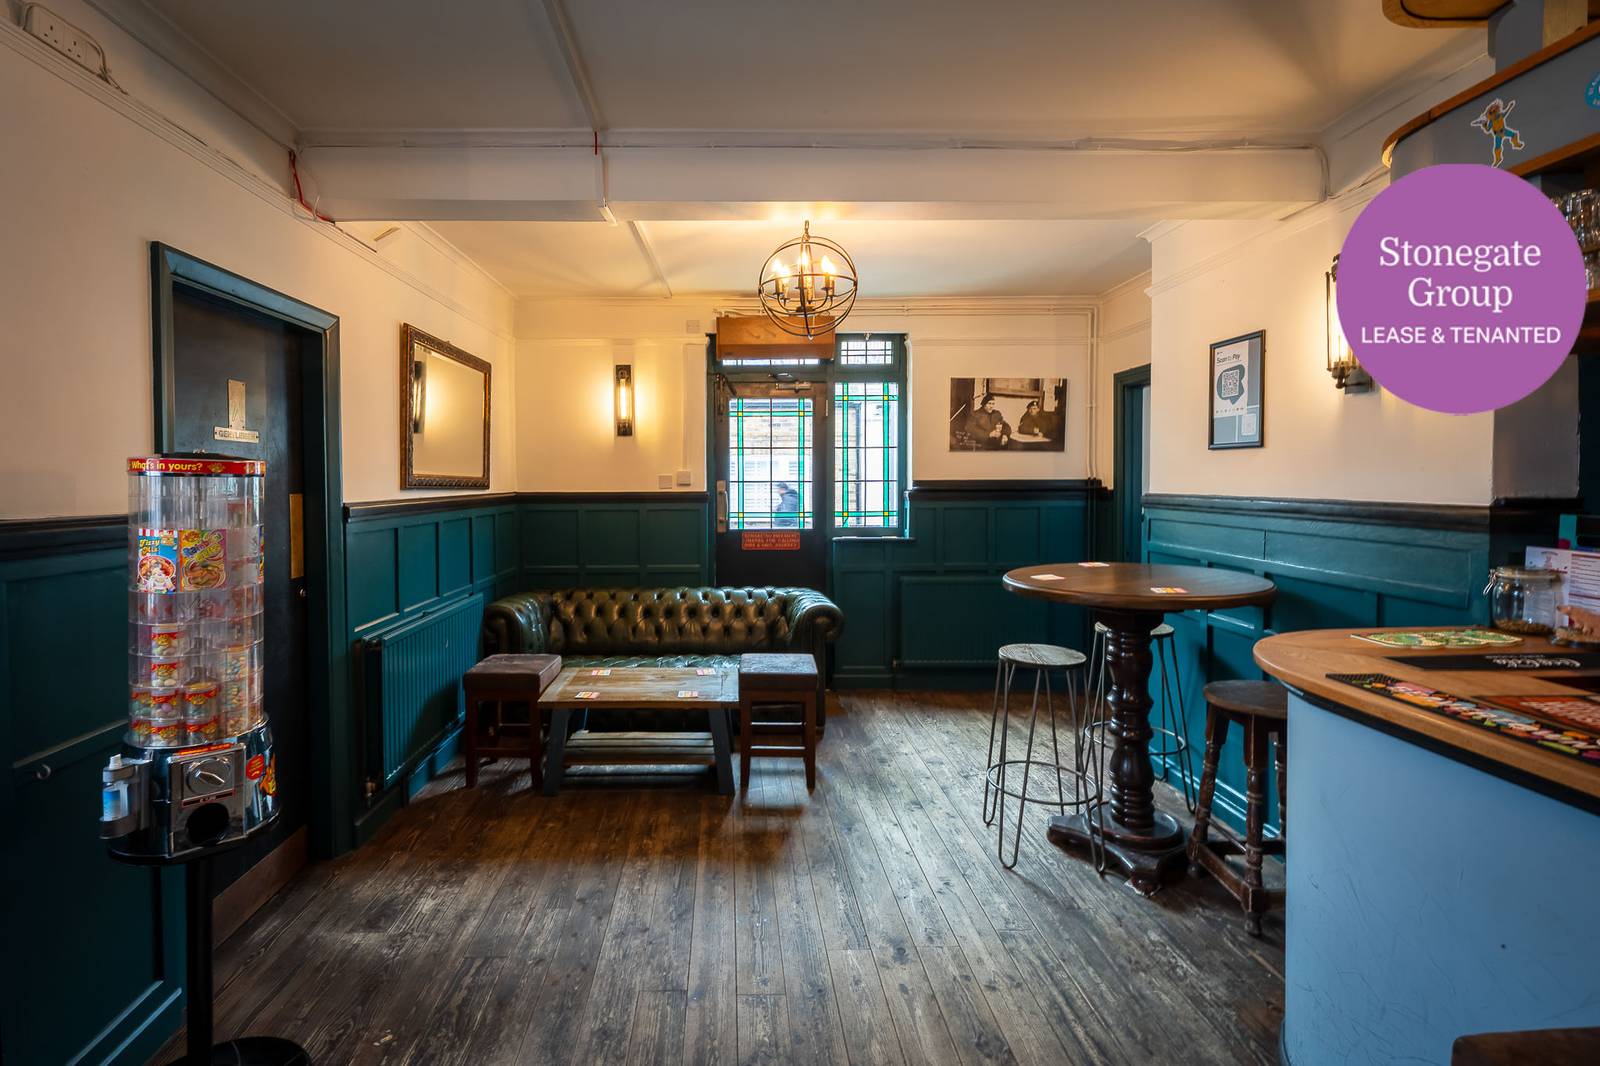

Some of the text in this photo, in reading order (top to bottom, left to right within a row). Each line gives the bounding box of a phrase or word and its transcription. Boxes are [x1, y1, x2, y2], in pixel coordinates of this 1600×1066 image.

[131, 460, 155, 470] What's
[156, 461, 165, 470] in
[168, 462, 203, 471] yours?
